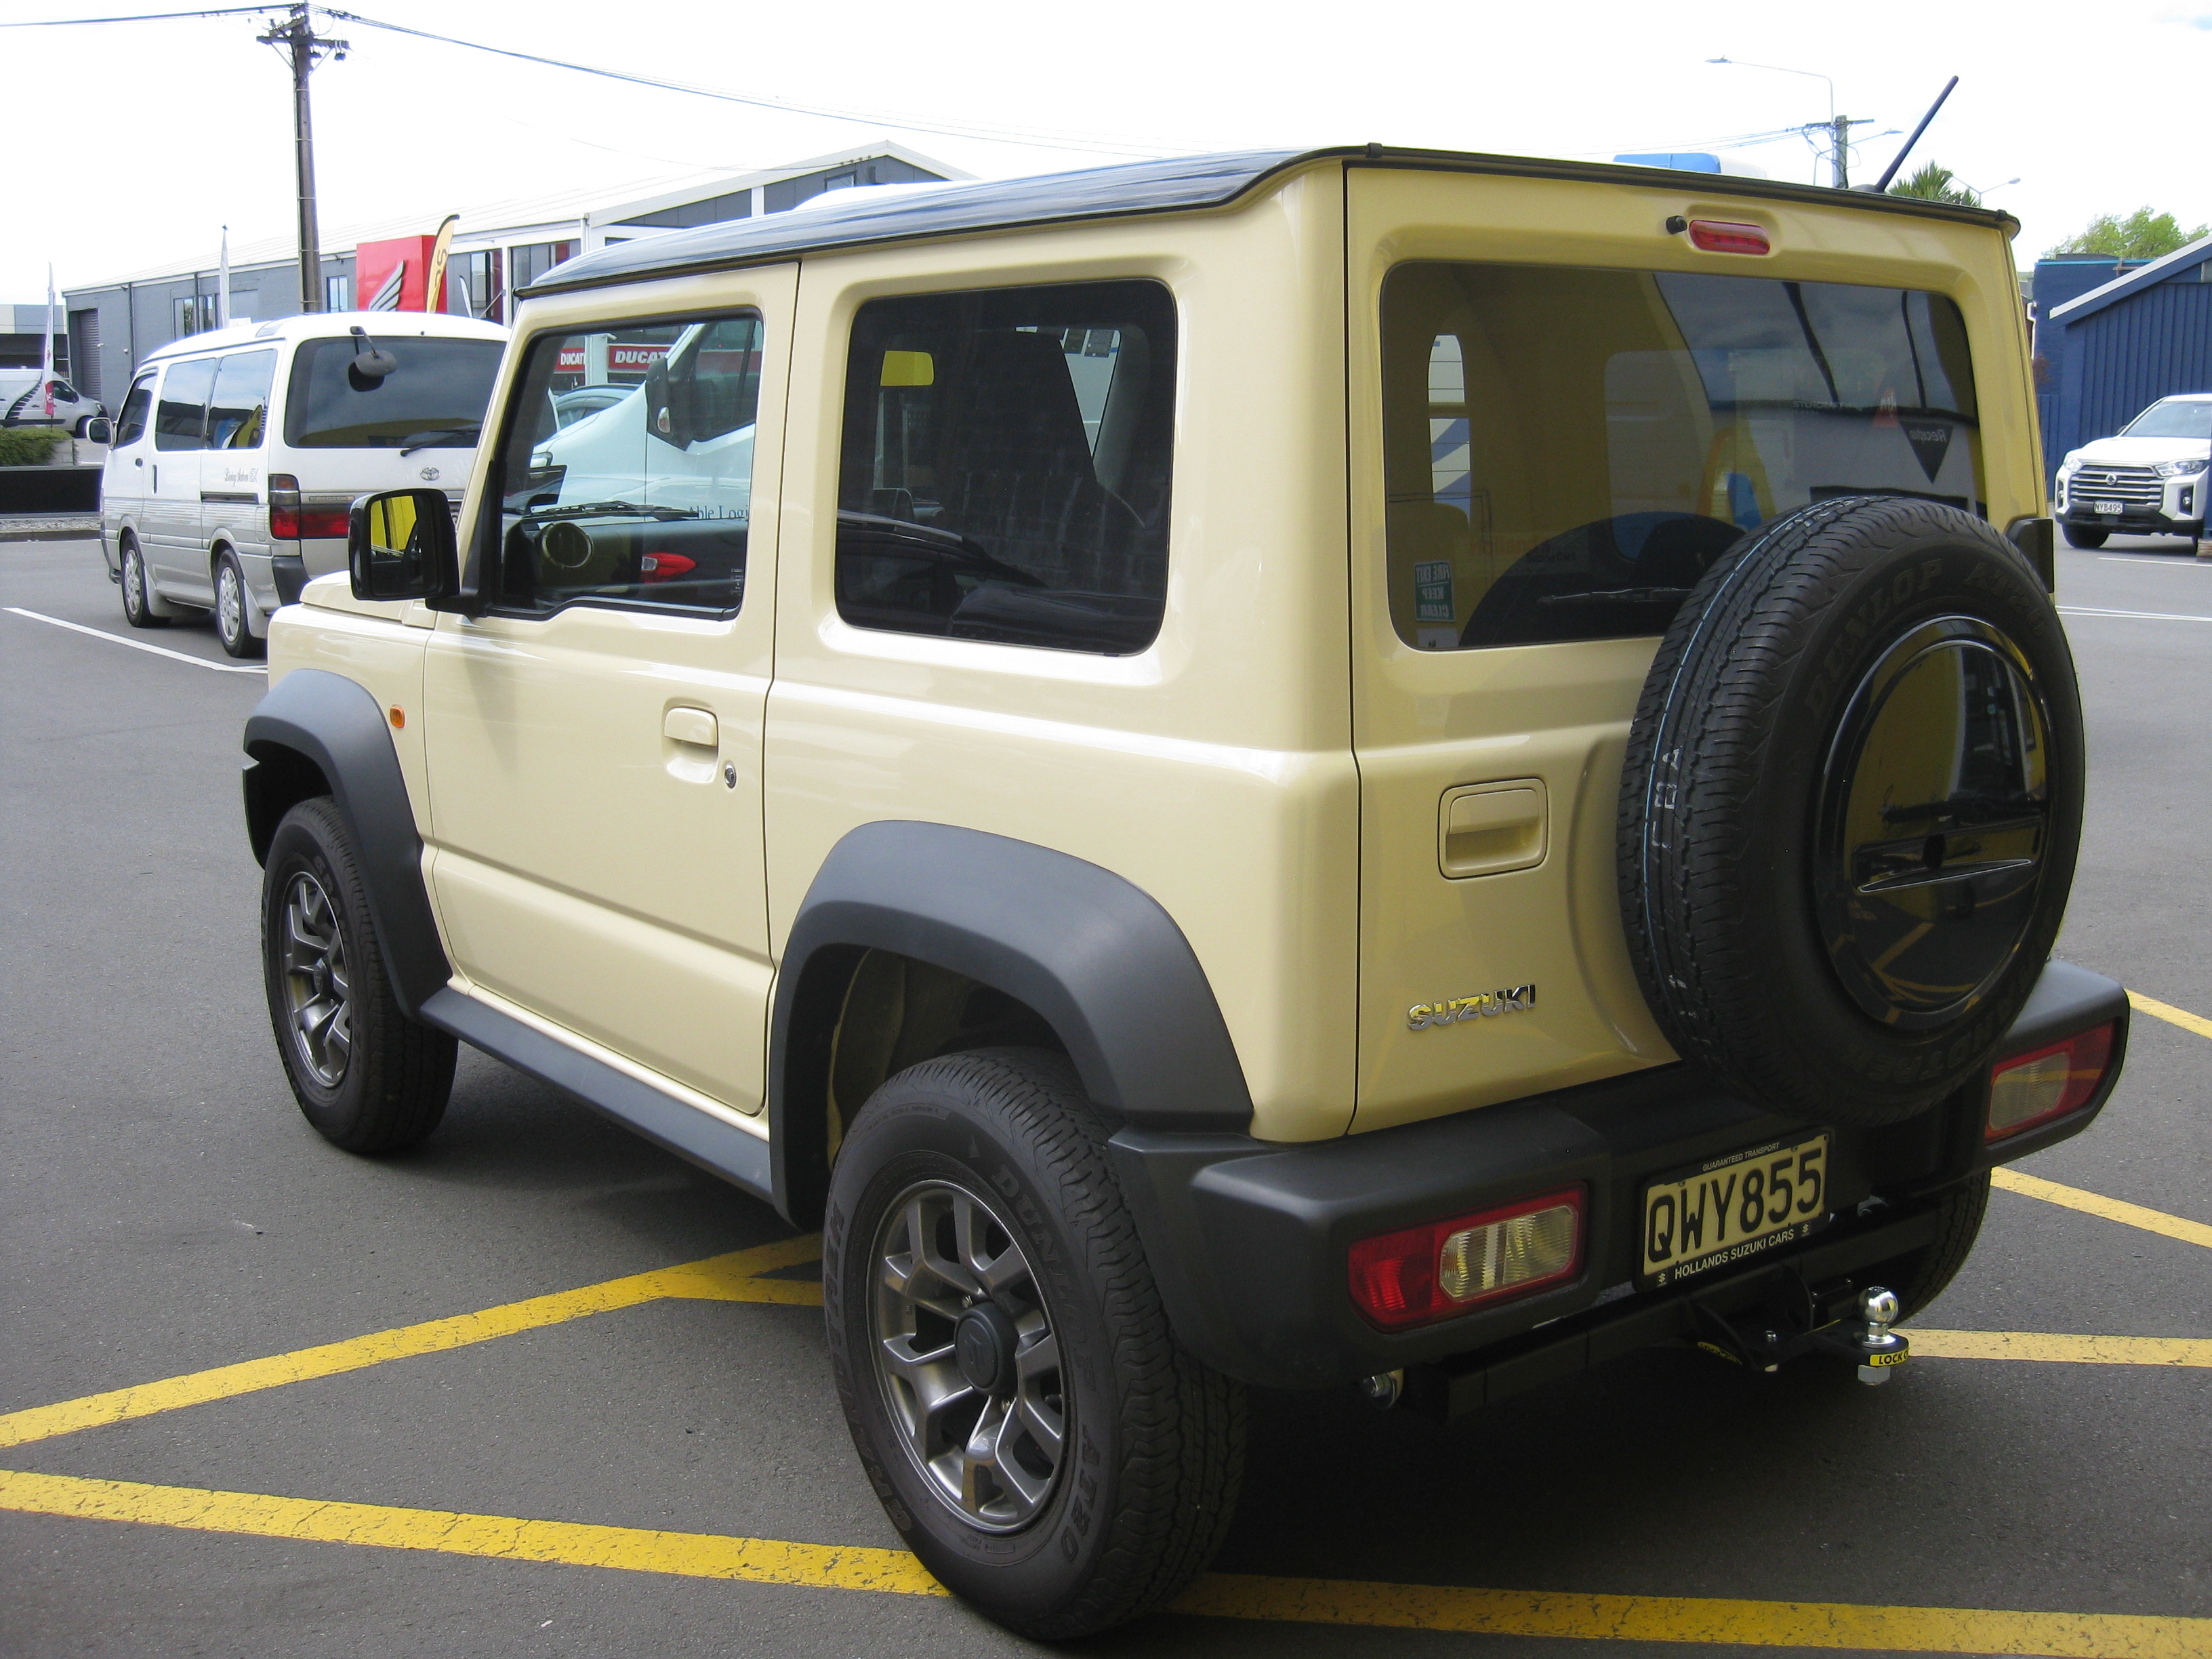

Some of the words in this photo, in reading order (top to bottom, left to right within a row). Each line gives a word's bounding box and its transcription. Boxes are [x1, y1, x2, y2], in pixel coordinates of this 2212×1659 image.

[2094, 502, 2123, 513] NYB495
[1408, 984, 1536, 1031] SUZUKI
[1702, 1153, 1744, 1171] GUARANTEED
[1744, 1141, 1780, 1158] TRANSPORT
[1647, 1147, 1822, 1263] QWY855
[1675, 1251, 1729, 1279] HOLLANDS
[1730, 1237, 1766, 1261] SUZUKI
[1768, 1228, 1795, 1247] CARS
[1879, 1352, 1902, 1365] LOCK
